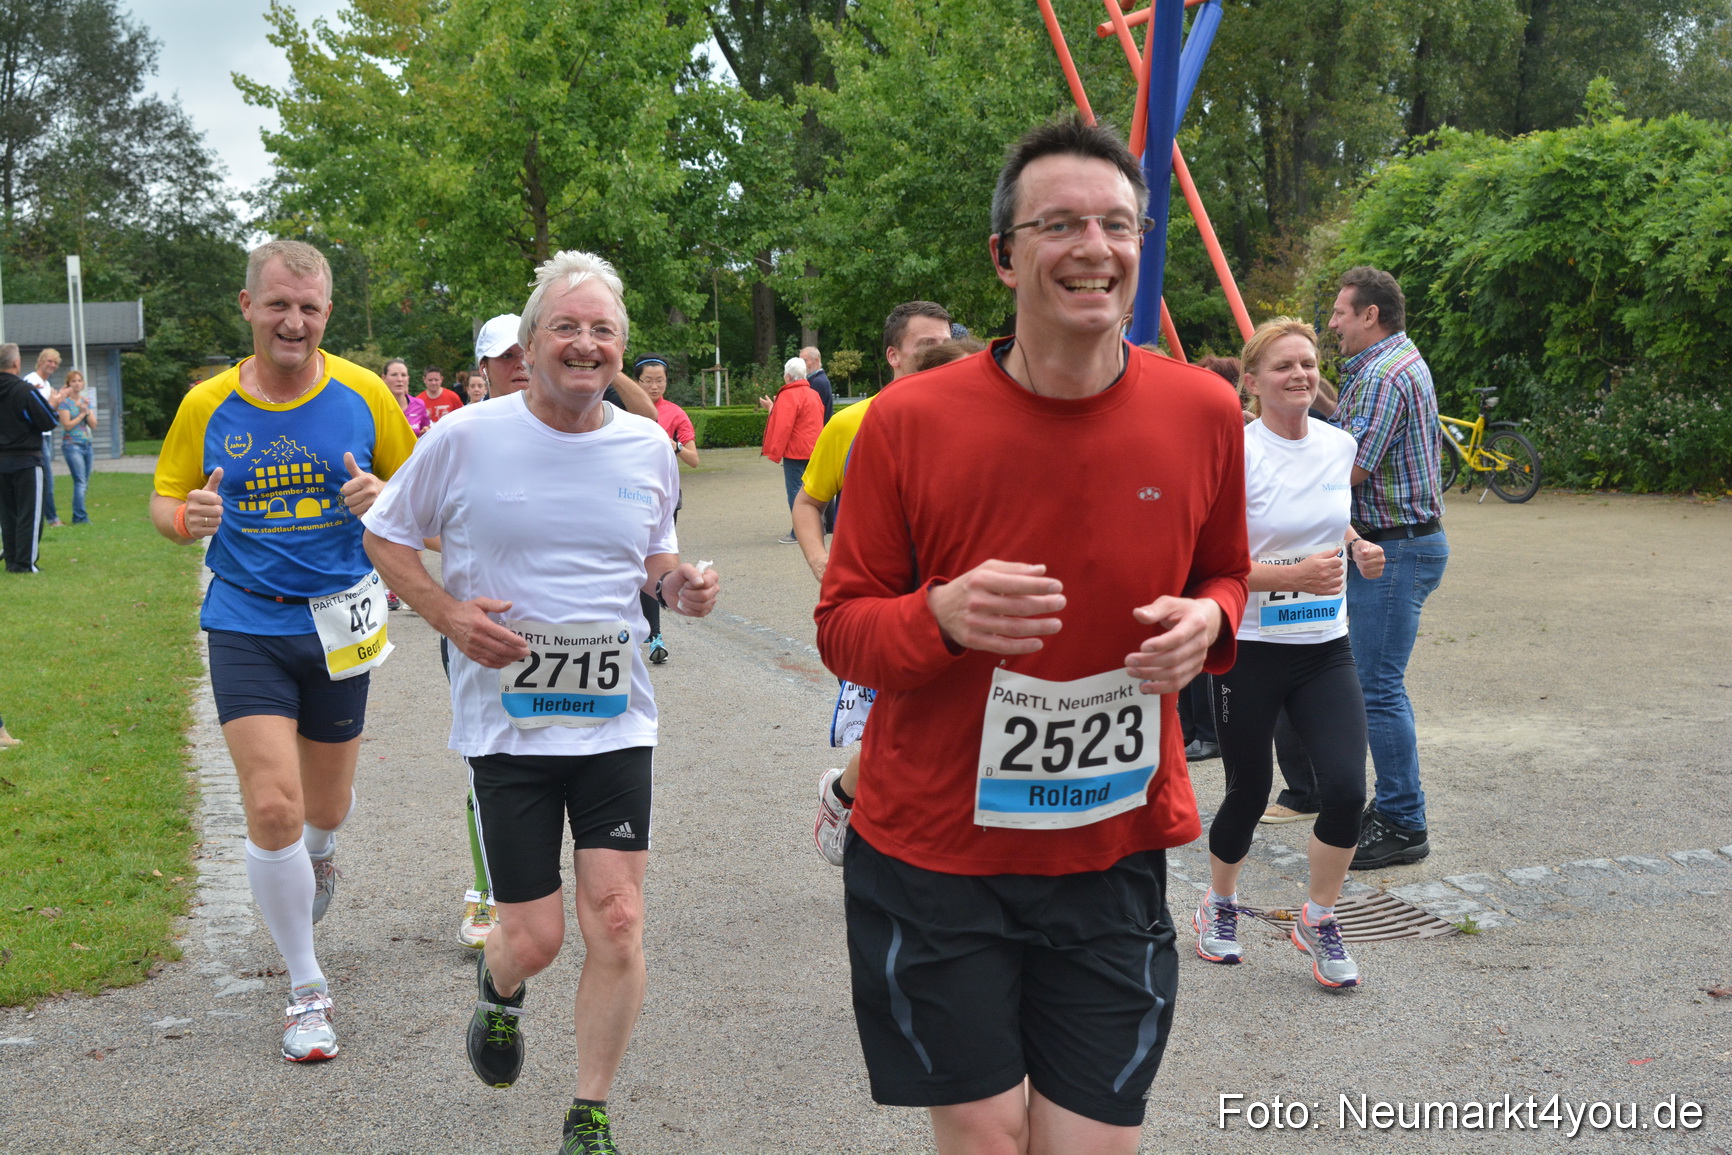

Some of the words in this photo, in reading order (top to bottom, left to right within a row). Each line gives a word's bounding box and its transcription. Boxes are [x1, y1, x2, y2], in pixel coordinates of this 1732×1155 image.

[306, 486, 325, 494] 2014
[241, 519, 343, 533] www.stadtlauf-neumarkt.de
[312, 596, 344, 612] PARTL
[349, 597, 378, 635] 42
[1278, 606, 1336, 621] Marianne
[554, 634, 613, 646] Neumarkt
[513, 650, 620, 690] 2715
[532, 697, 595, 713] Herbert
[992, 686, 1053, 711] PARTL
[1058, 684, 1134, 711] Neumarkt
[1222, 695, 1230, 723] odlo
[999, 704, 1144, 773] 2523
[985, 766, 993, 777] D
[1028, 782, 1111, 806] Roland
[610, 831, 635, 839] adidas
